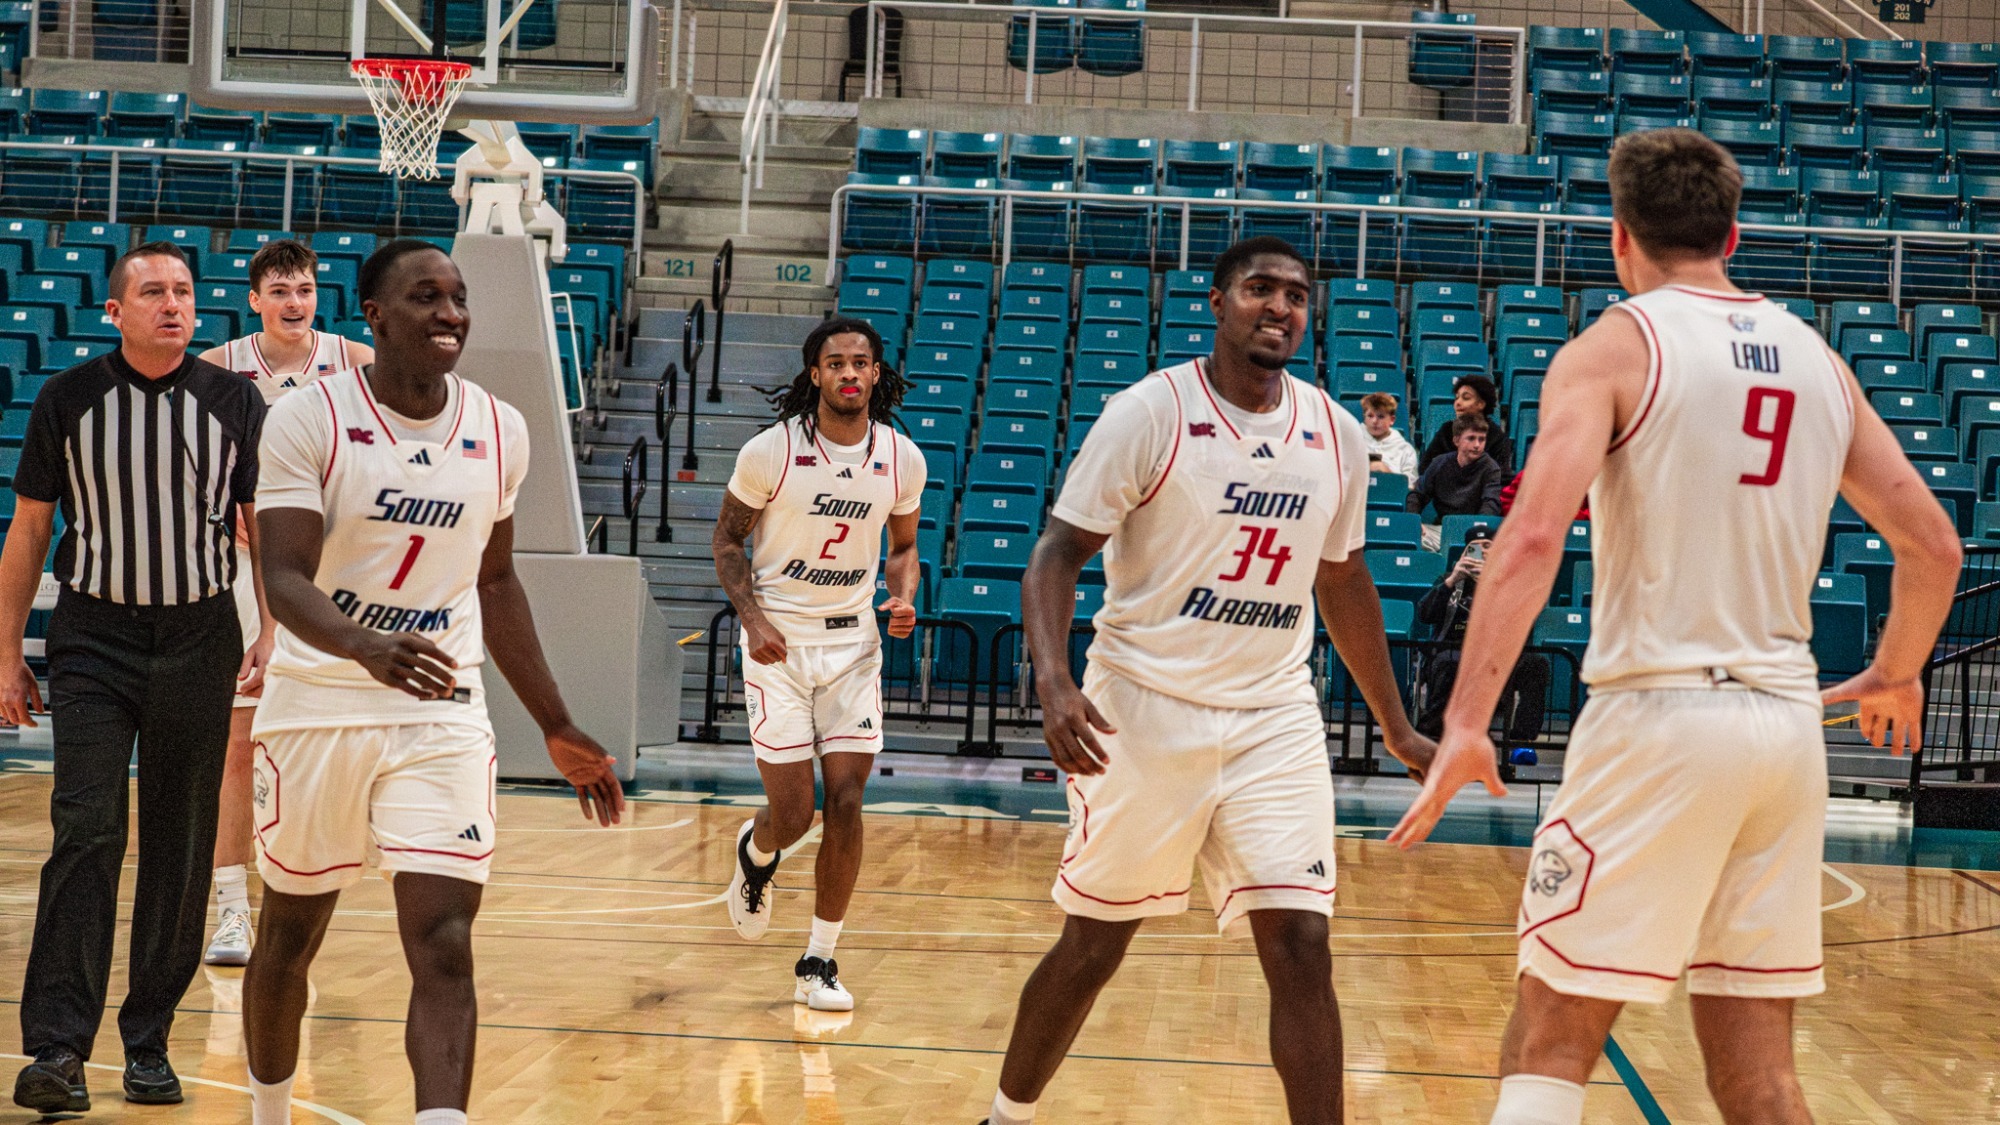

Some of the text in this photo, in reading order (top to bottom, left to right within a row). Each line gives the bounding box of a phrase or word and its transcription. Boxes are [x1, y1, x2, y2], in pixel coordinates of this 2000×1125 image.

[1893, 12, 1911, 20] 202
[1894, 3, 1910, 12] 201
[664, 259, 694, 277] 121
[776, 264, 812, 282] 102
[1731, 341, 1780, 374] LAW
[1738, 386, 1796, 487] 9
[366, 488, 464, 529] SOUTH
[808, 493, 872, 520] SOUTH
[1217, 482, 1308, 520] SOUTH
[819, 523, 850, 560] 2
[1217, 525, 1292, 585] 34
[388, 535, 426, 591] 1
[781, 559, 867, 587] ALABAMA
[1179, 587, 1302, 629] ALABAMA
